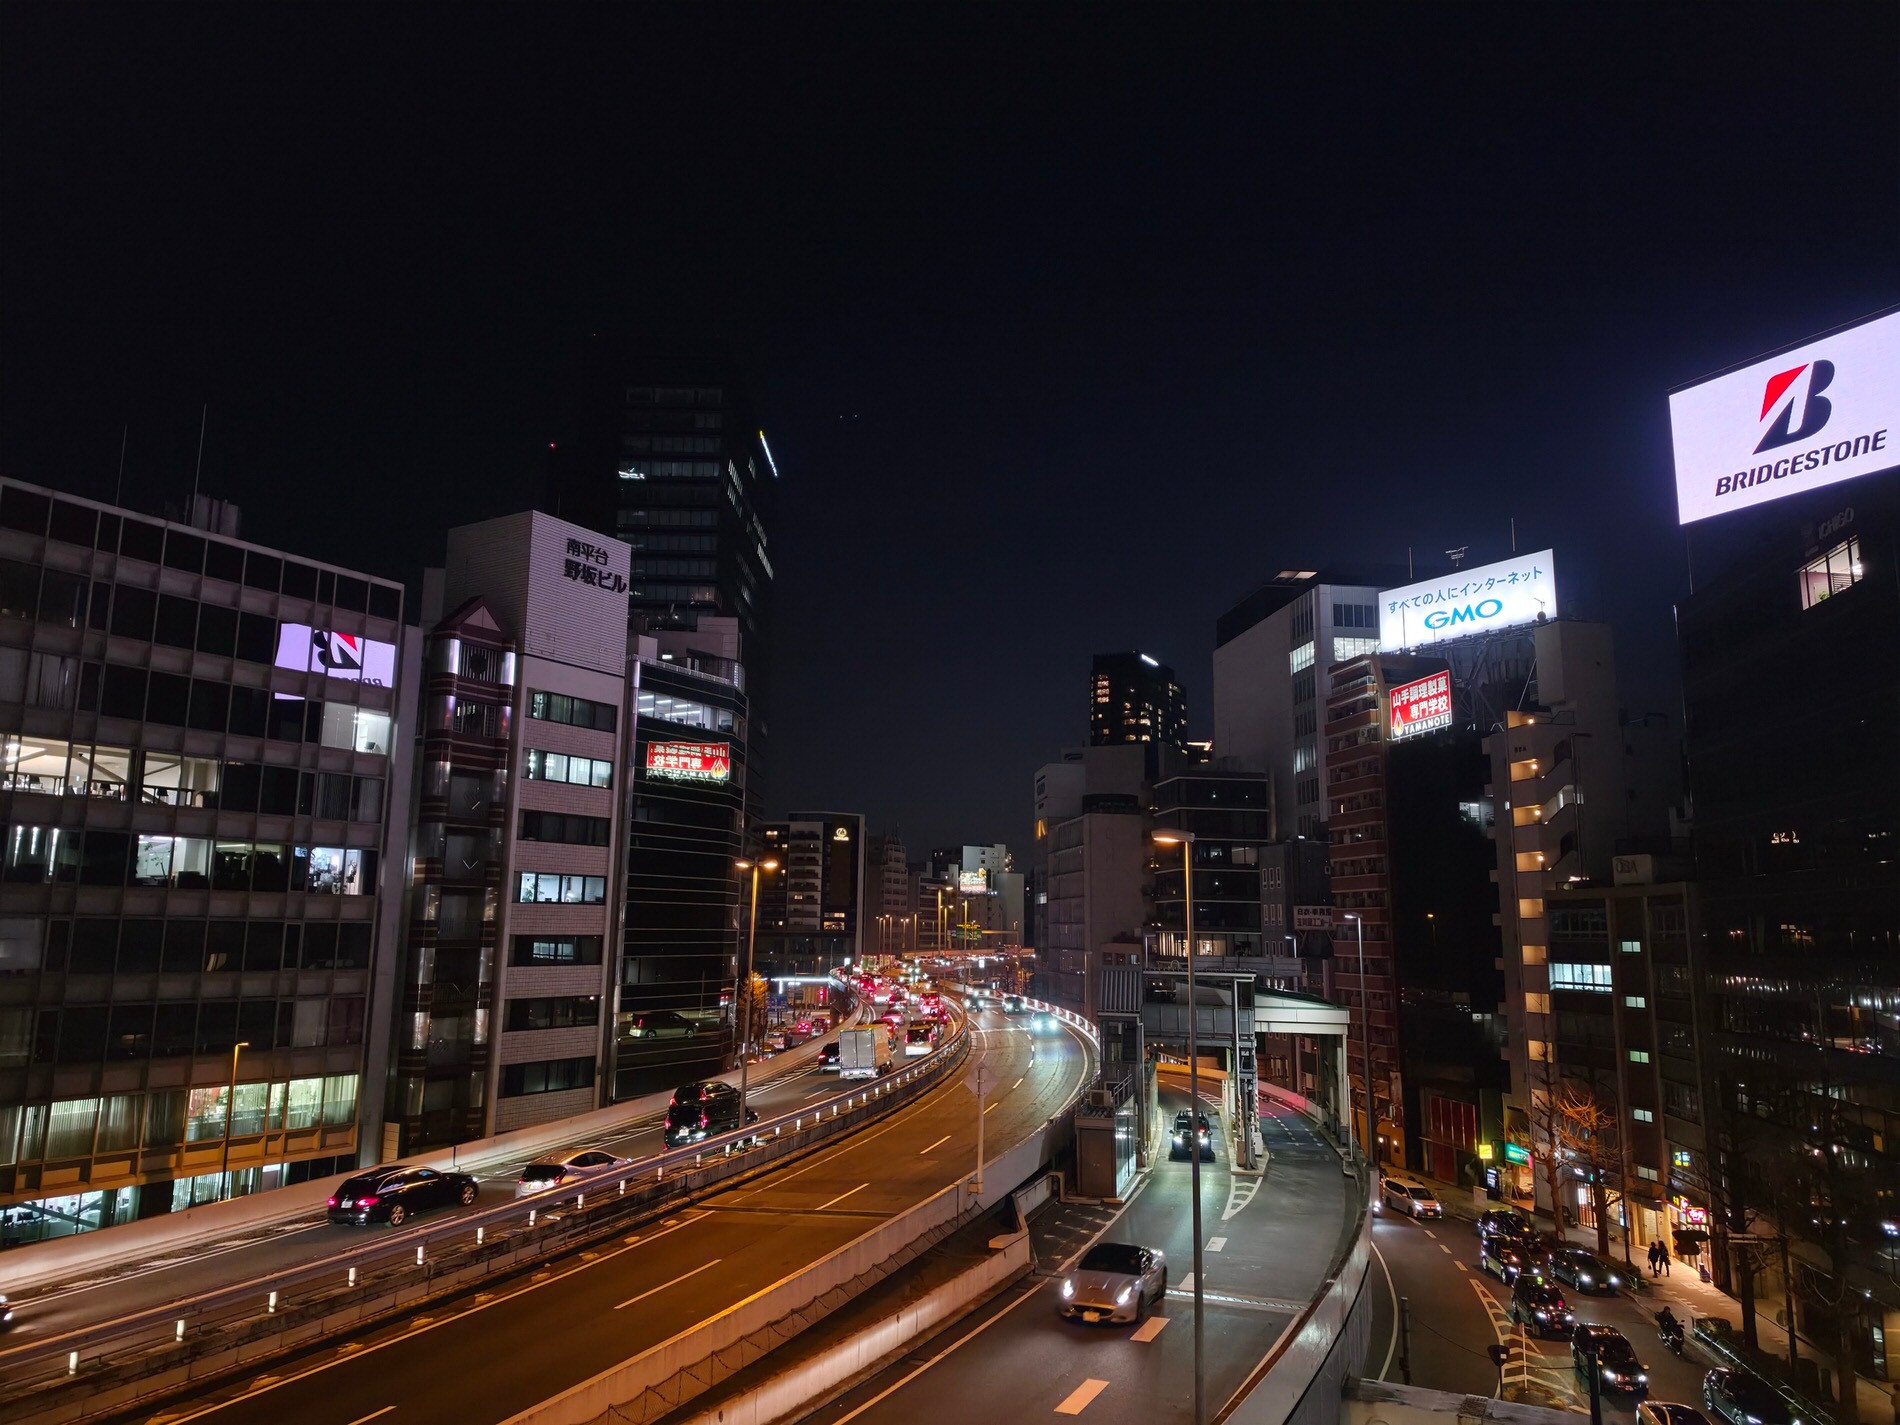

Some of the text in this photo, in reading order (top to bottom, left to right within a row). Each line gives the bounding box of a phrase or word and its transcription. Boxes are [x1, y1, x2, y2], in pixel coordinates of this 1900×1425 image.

[1715, 428, 1888, 497] BRIDGESTONE
[566, 538, 609, 566] 南平台
[563, 558, 628, 593] 野坂ビル
[1388, 566, 1543, 614] すべての人にインターネット
[1424, 598, 1503, 630] GMO
[1392, 675, 1448, 708] 山手調理製菓
[1410, 694, 1449, 719] 専門学校
[1404, 714, 1450, 735] YAMANOTE
